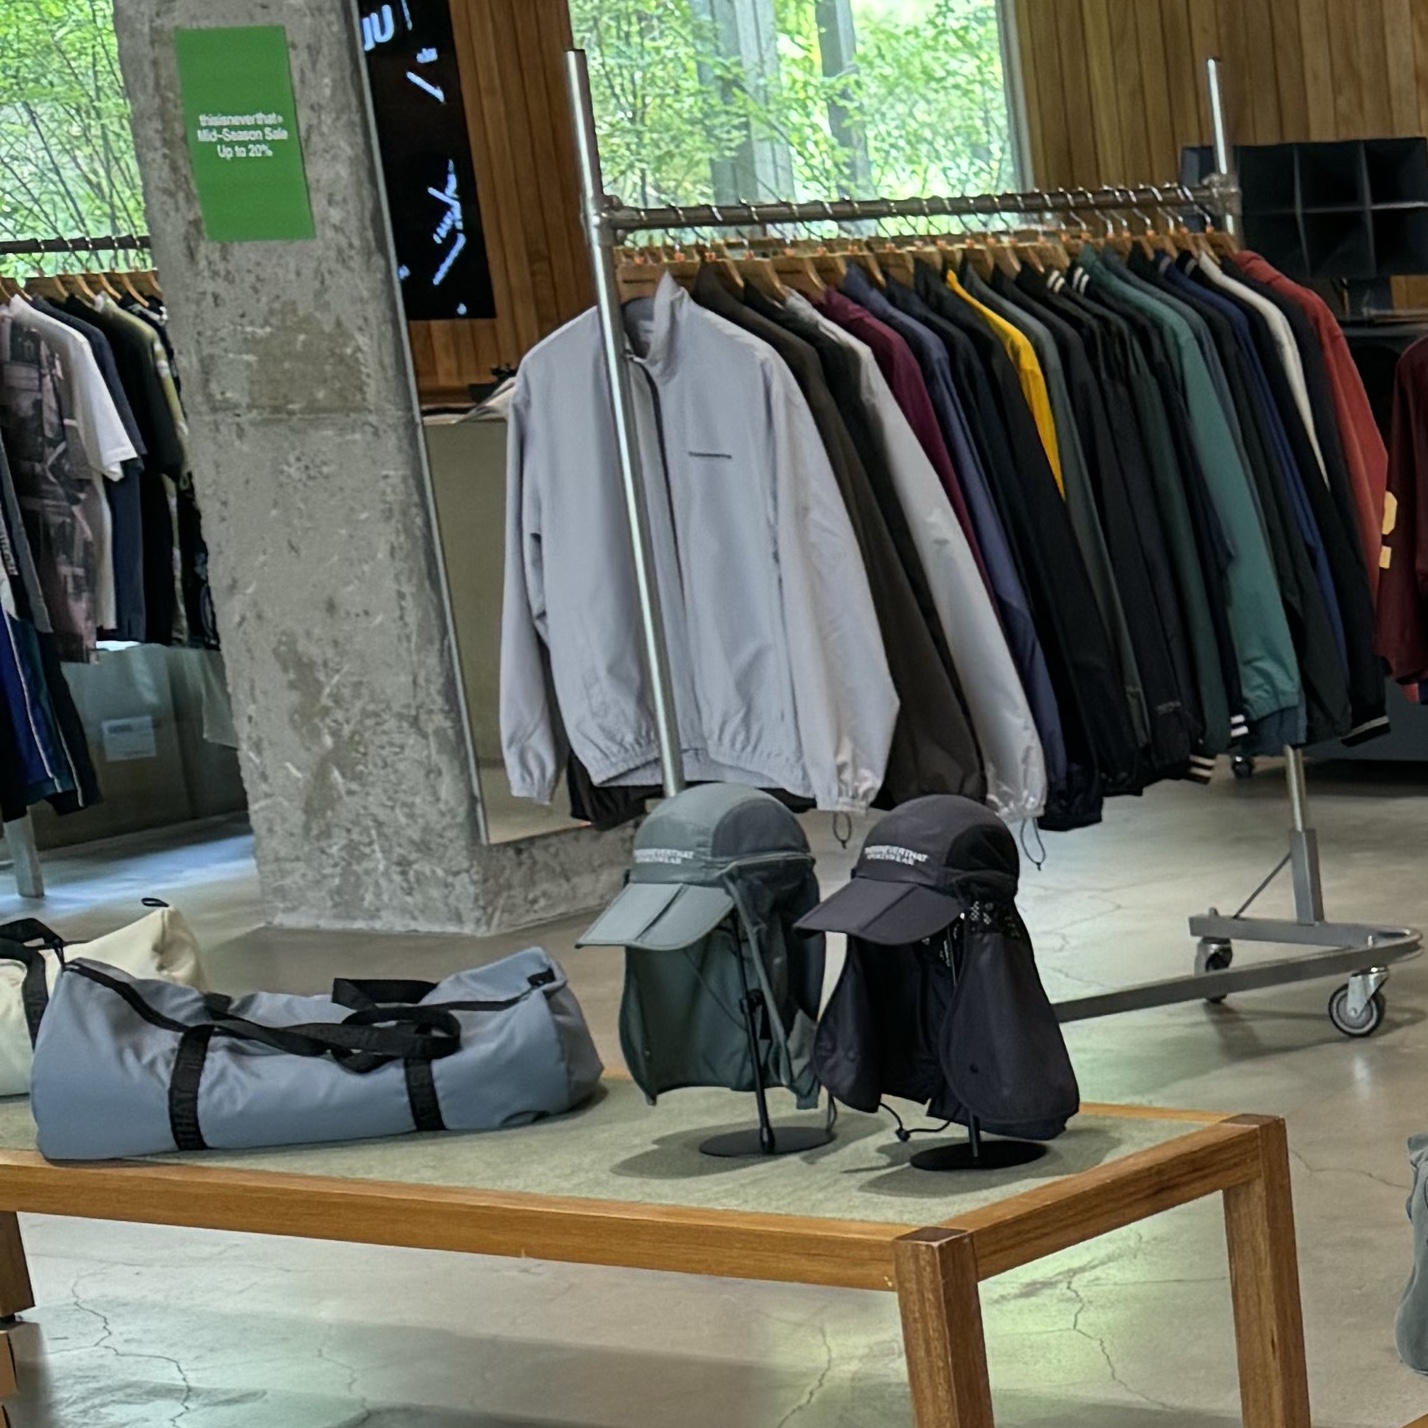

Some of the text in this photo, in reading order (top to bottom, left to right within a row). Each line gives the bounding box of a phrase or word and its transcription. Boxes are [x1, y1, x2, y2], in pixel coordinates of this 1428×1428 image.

[197, 127, 288, 141] Mid-Season Sale
[217, 144, 273, 160] Up to 20%
